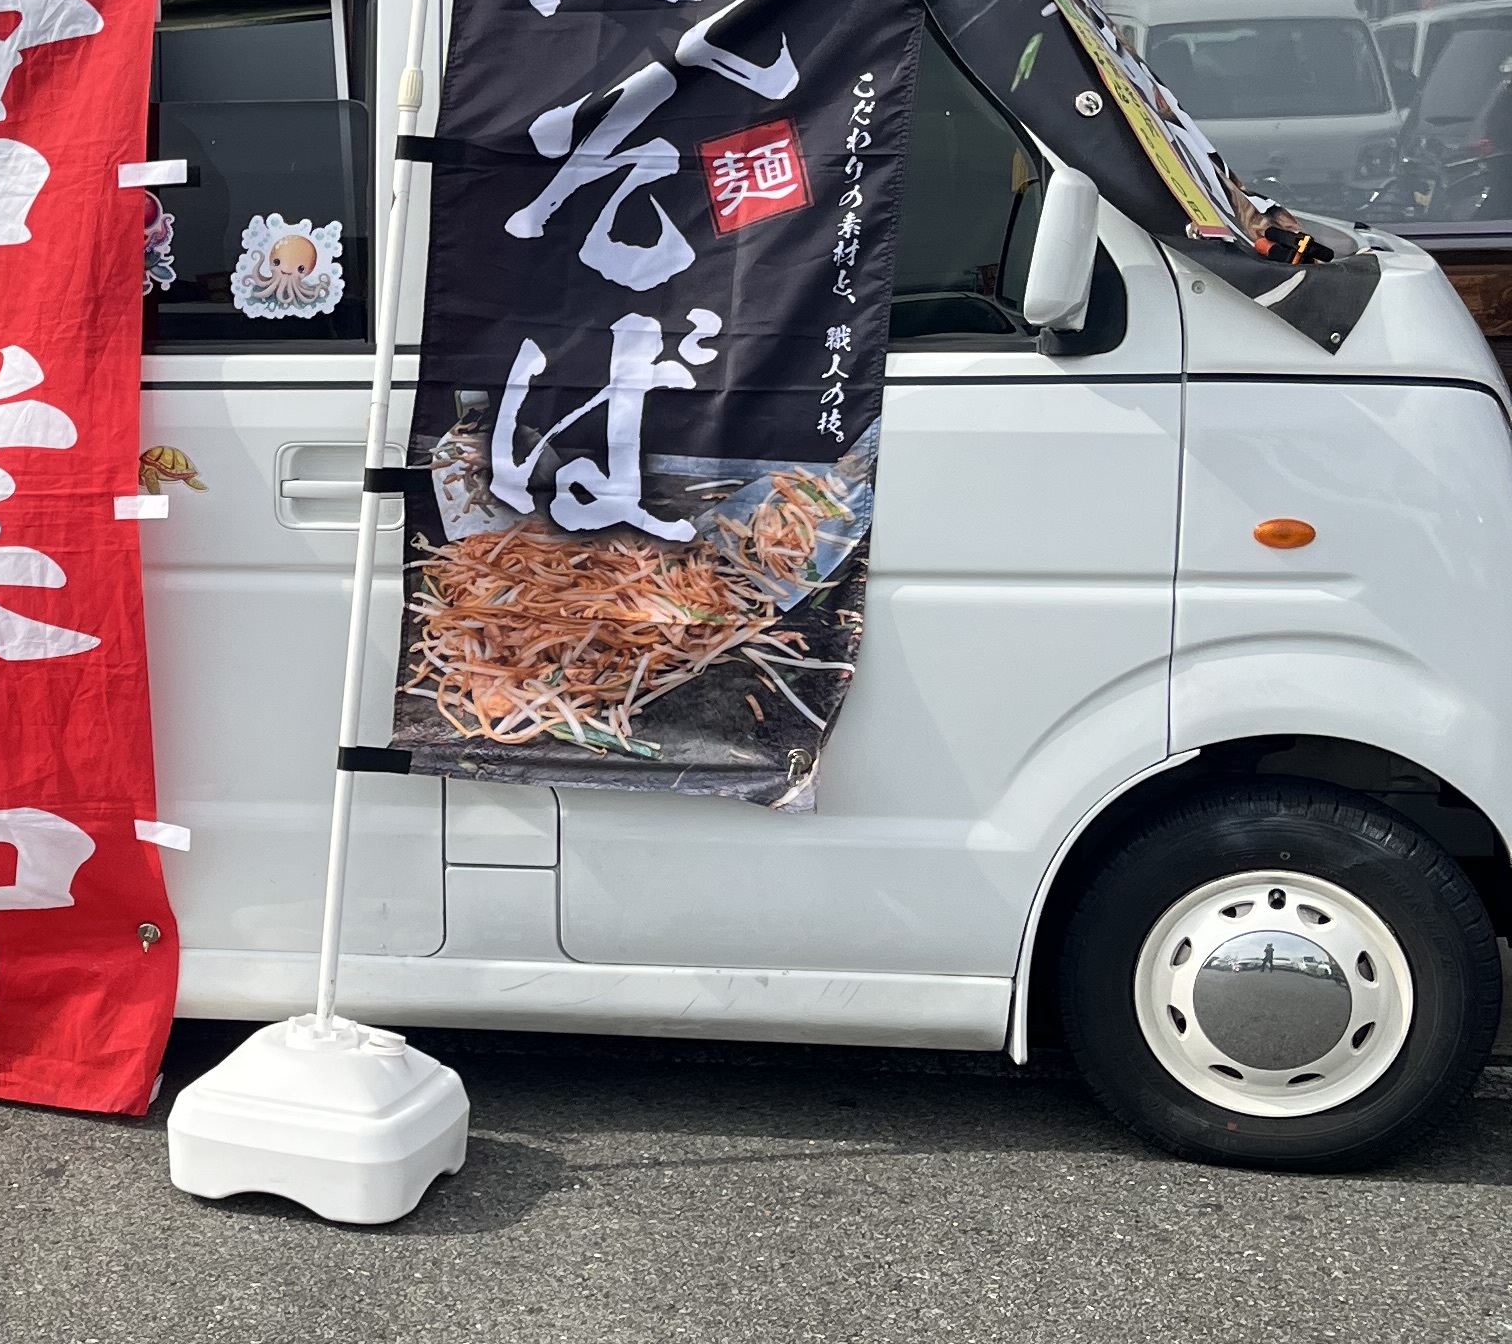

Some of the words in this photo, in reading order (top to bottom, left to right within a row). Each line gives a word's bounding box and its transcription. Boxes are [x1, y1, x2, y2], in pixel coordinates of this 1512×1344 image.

[712, 137, 800, 217] 麺
[817, 324, 852, 444] 職人の技。
